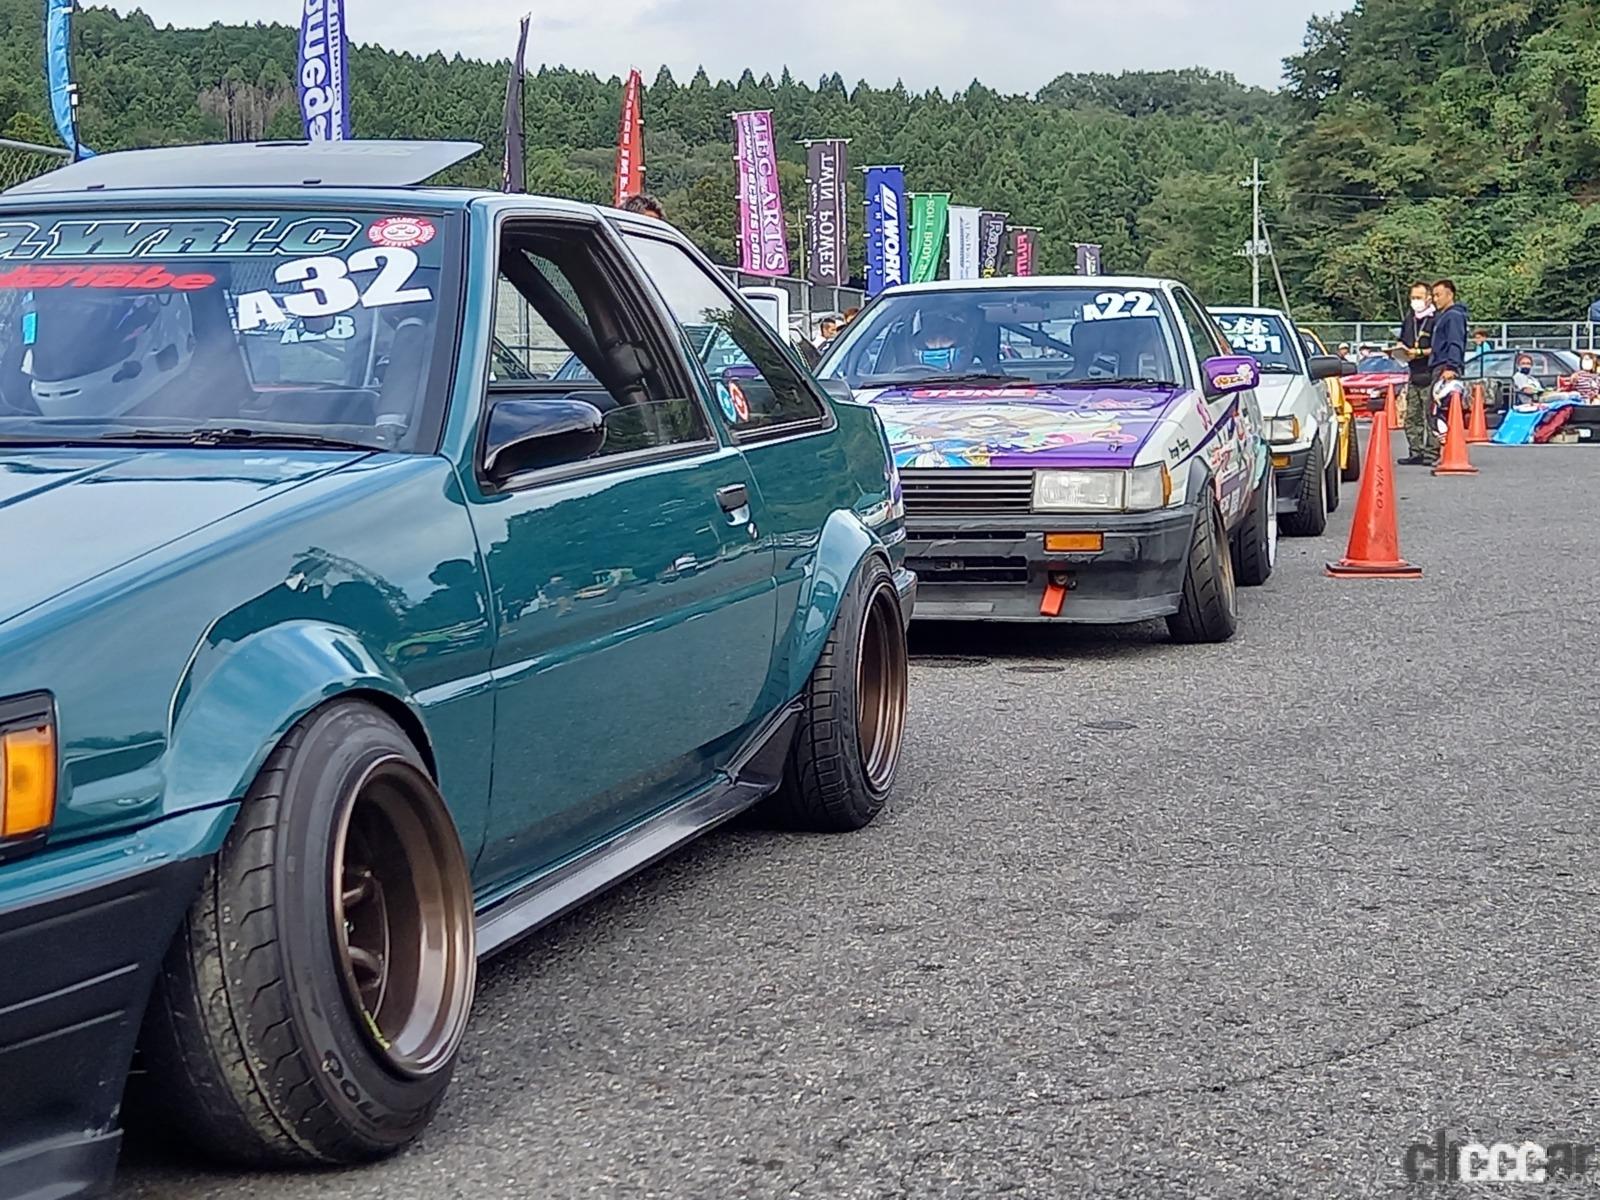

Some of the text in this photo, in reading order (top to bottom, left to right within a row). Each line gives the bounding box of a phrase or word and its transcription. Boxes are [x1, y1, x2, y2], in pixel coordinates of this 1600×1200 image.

[925, 200, 935, 228] SOUL
[874, 194, 882, 275] WHEELS
[884, 220, 901, 286] WORK
[921, 232, 933, 260] BODY
[238, 246, 432, 331] A32
[1083, 291, 1160, 321] A22
[926, 388, 1032, 398] TONE
[1375, 464, 1385, 508] NIKKO
